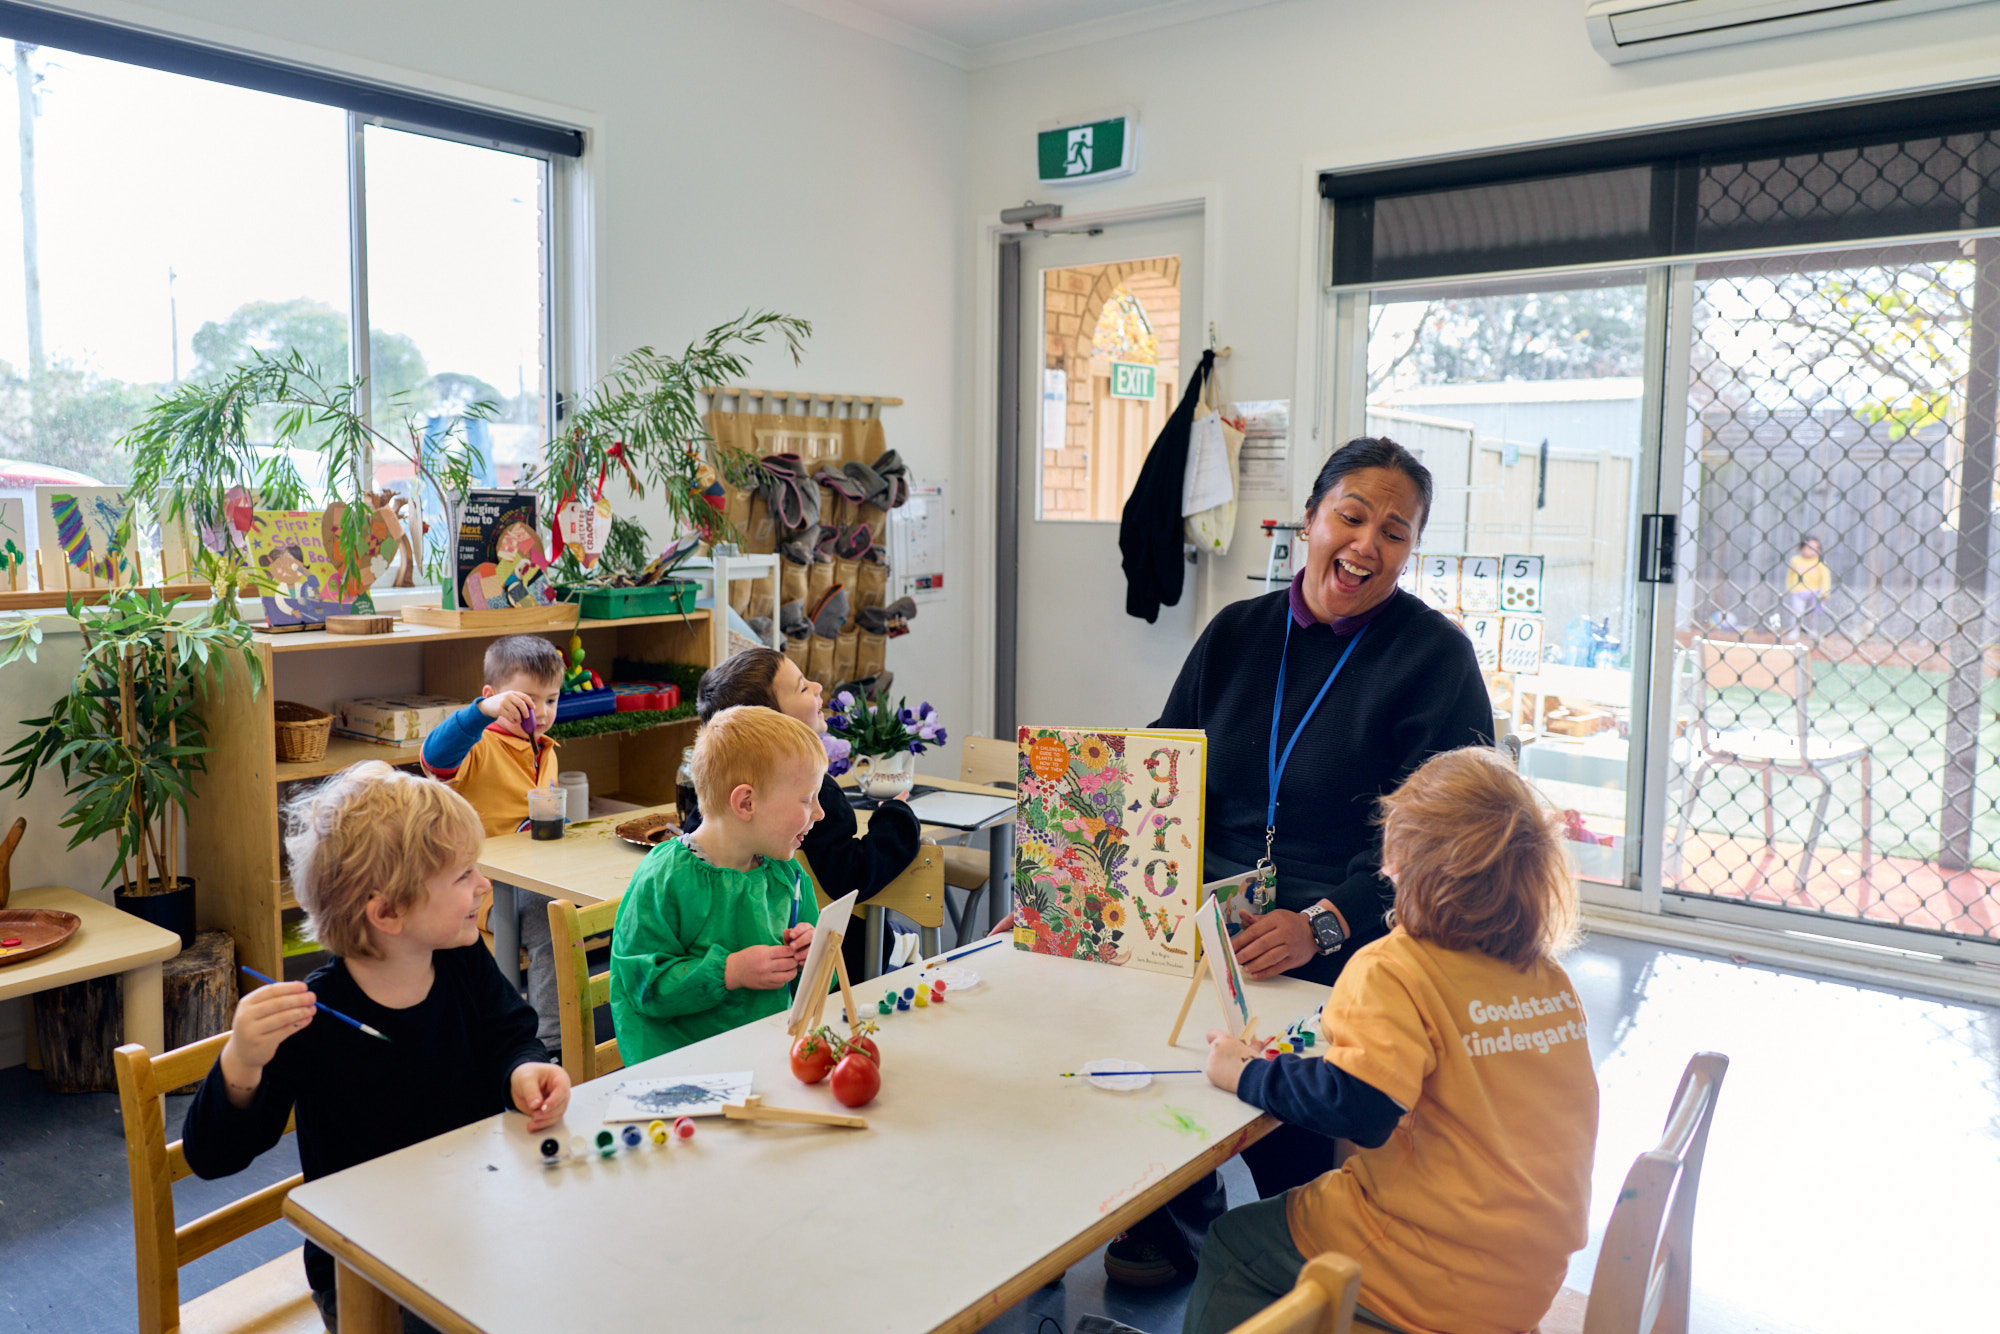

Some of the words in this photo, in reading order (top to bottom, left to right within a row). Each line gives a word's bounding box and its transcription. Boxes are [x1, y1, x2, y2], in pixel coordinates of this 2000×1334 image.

[1117, 365, 1151, 395] EXIT
[464, 503, 500, 518] ridging
[274, 519, 309, 533] First
[460, 524, 481, 534] Next
[481, 515, 493, 525] to
[271, 532, 325, 550] Scien
[308, 550, 333, 564] Boo
[1433, 559, 1446, 577] 3
[1473, 561, 1488, 579] 4
[1513, 559, 1530, 578] 5
[1475, 620, 1487, 639] 9
[1510, 622, 1534, 642] 10
[1468, 990, 1577, 1025] Goodstart
[1461, 1020, 1587, 1057] Kindergarte
